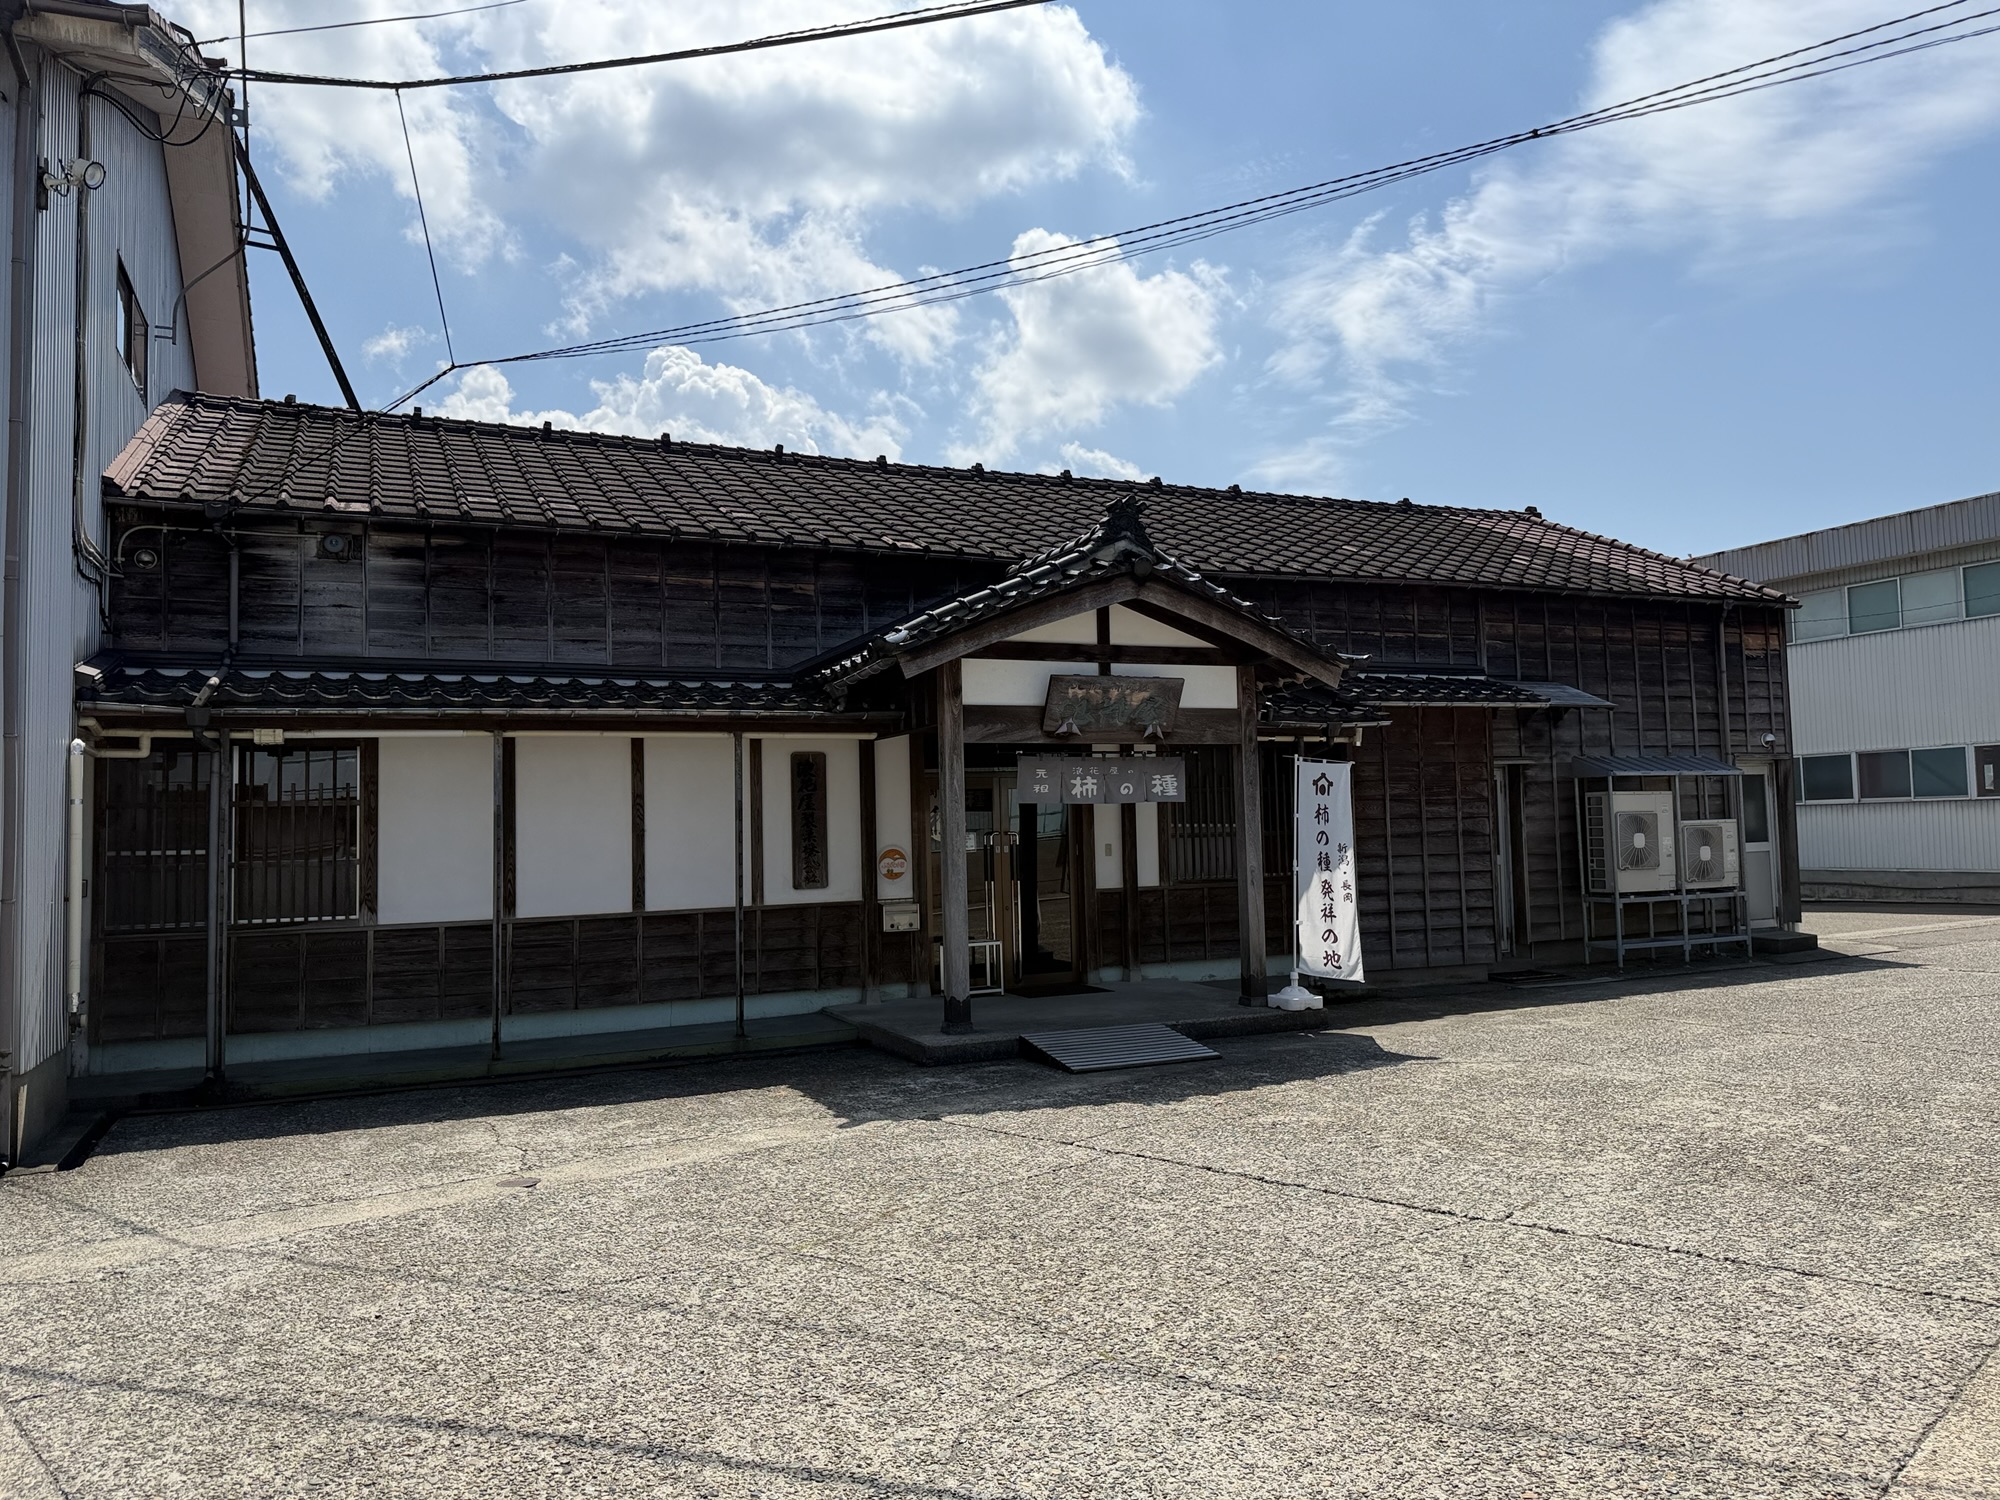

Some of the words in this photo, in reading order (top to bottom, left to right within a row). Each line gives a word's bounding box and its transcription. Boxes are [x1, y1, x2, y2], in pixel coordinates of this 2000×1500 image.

[1033, 768, 1049, 793] 元祖
[1072, 766, 1134, 775] 浪花屋の
[1070, 774, 1178, 799] 柿の種
[1337, 842, 1353, 904] 新潟・長岡
[1314, 803, 1343, 970] 柿の種発祥の地
